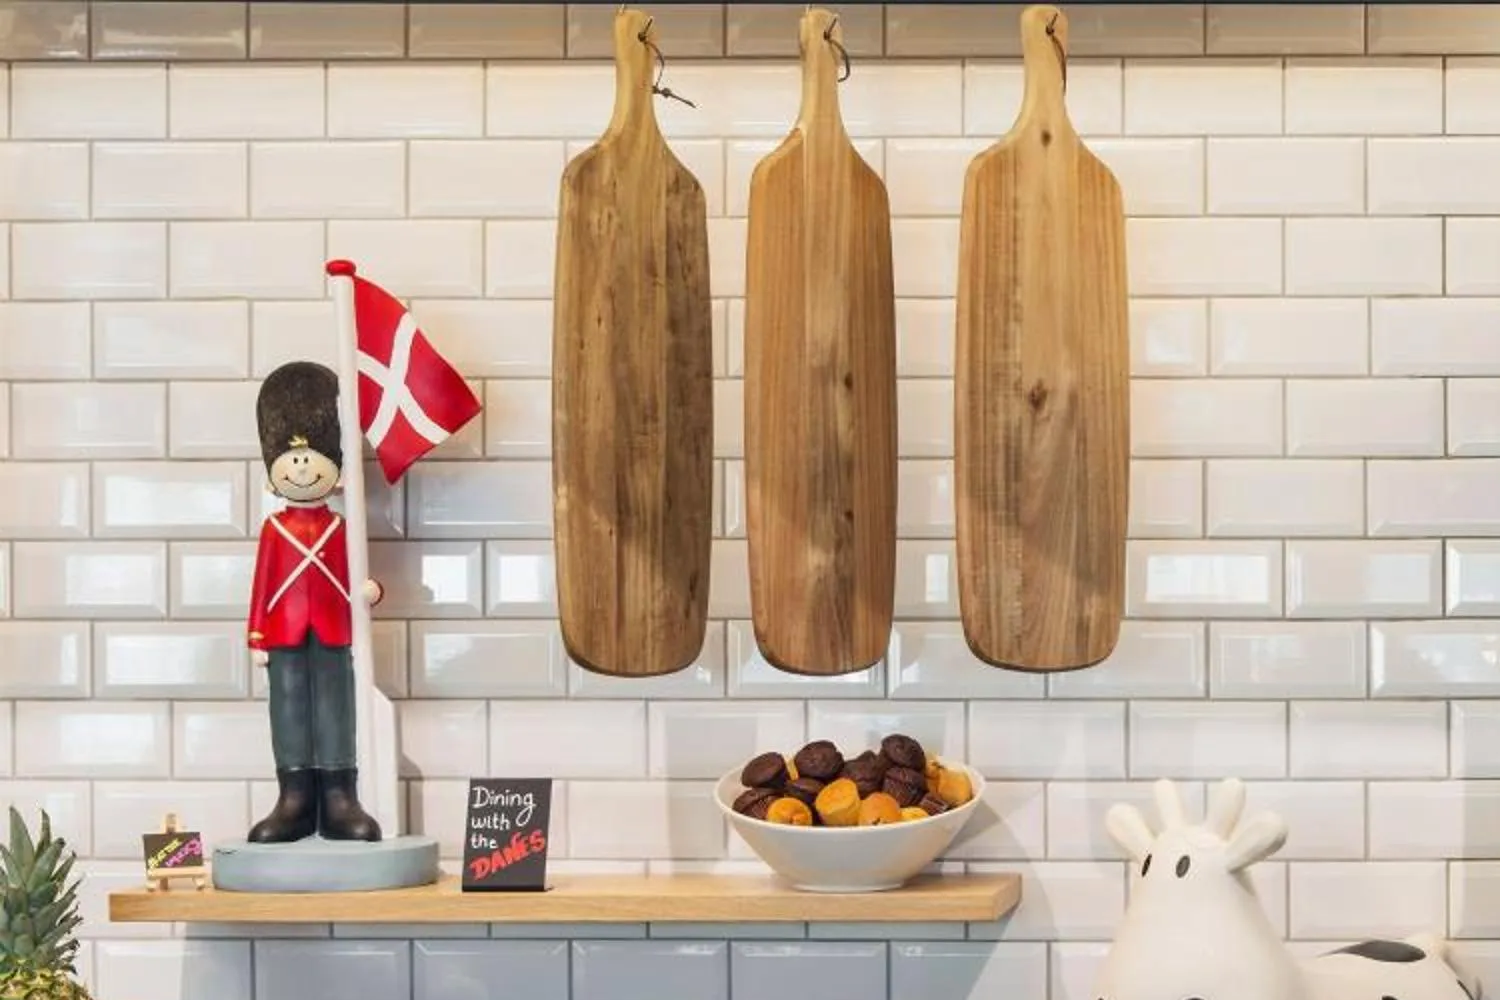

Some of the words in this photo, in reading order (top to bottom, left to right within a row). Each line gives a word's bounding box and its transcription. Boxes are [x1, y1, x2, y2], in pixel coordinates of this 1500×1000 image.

[471, 785, 537, 827] Dining
[471, 813, 511, 830] with
[469, 828, 546, 881] DANES
[470, 833, 499, 849] the
